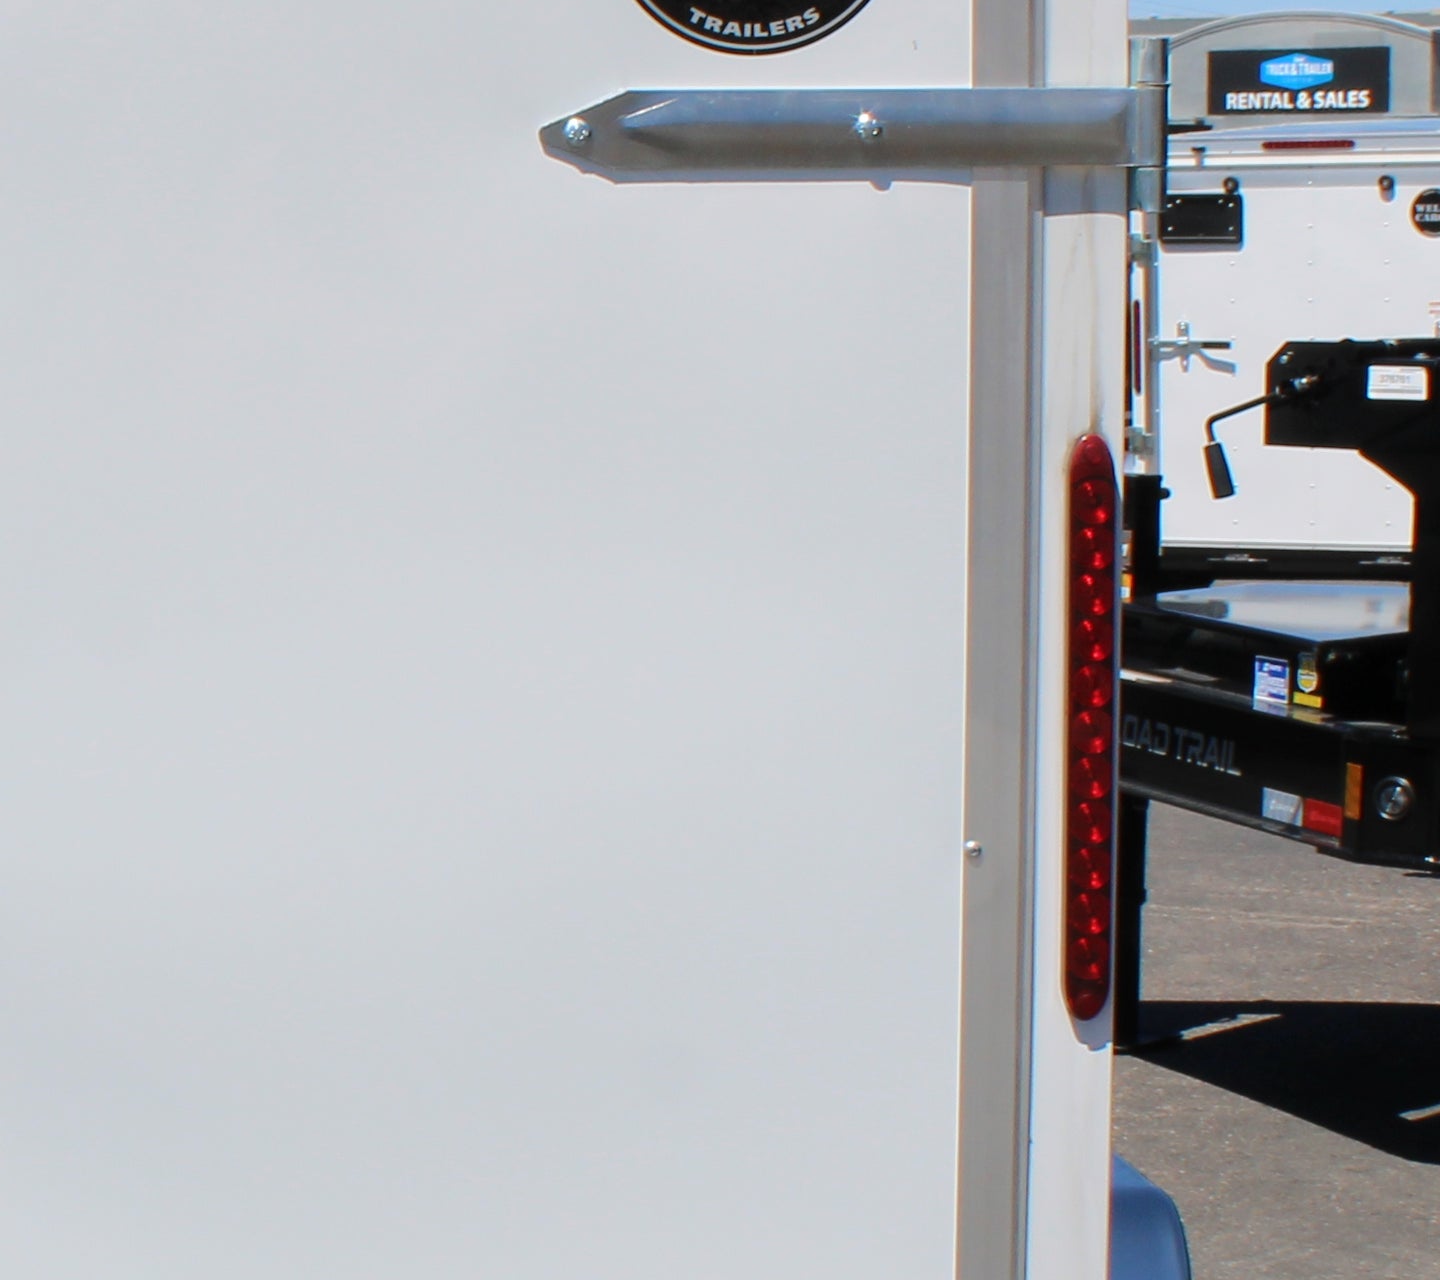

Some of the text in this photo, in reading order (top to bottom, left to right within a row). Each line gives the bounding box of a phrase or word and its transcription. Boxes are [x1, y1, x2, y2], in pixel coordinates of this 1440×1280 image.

[688, 6, 821, 38] TRAILERS
[1225, 89, 1372, 110] RENTAL & SALES
[1122, 713, 1243, 777] OAD TRAIL
